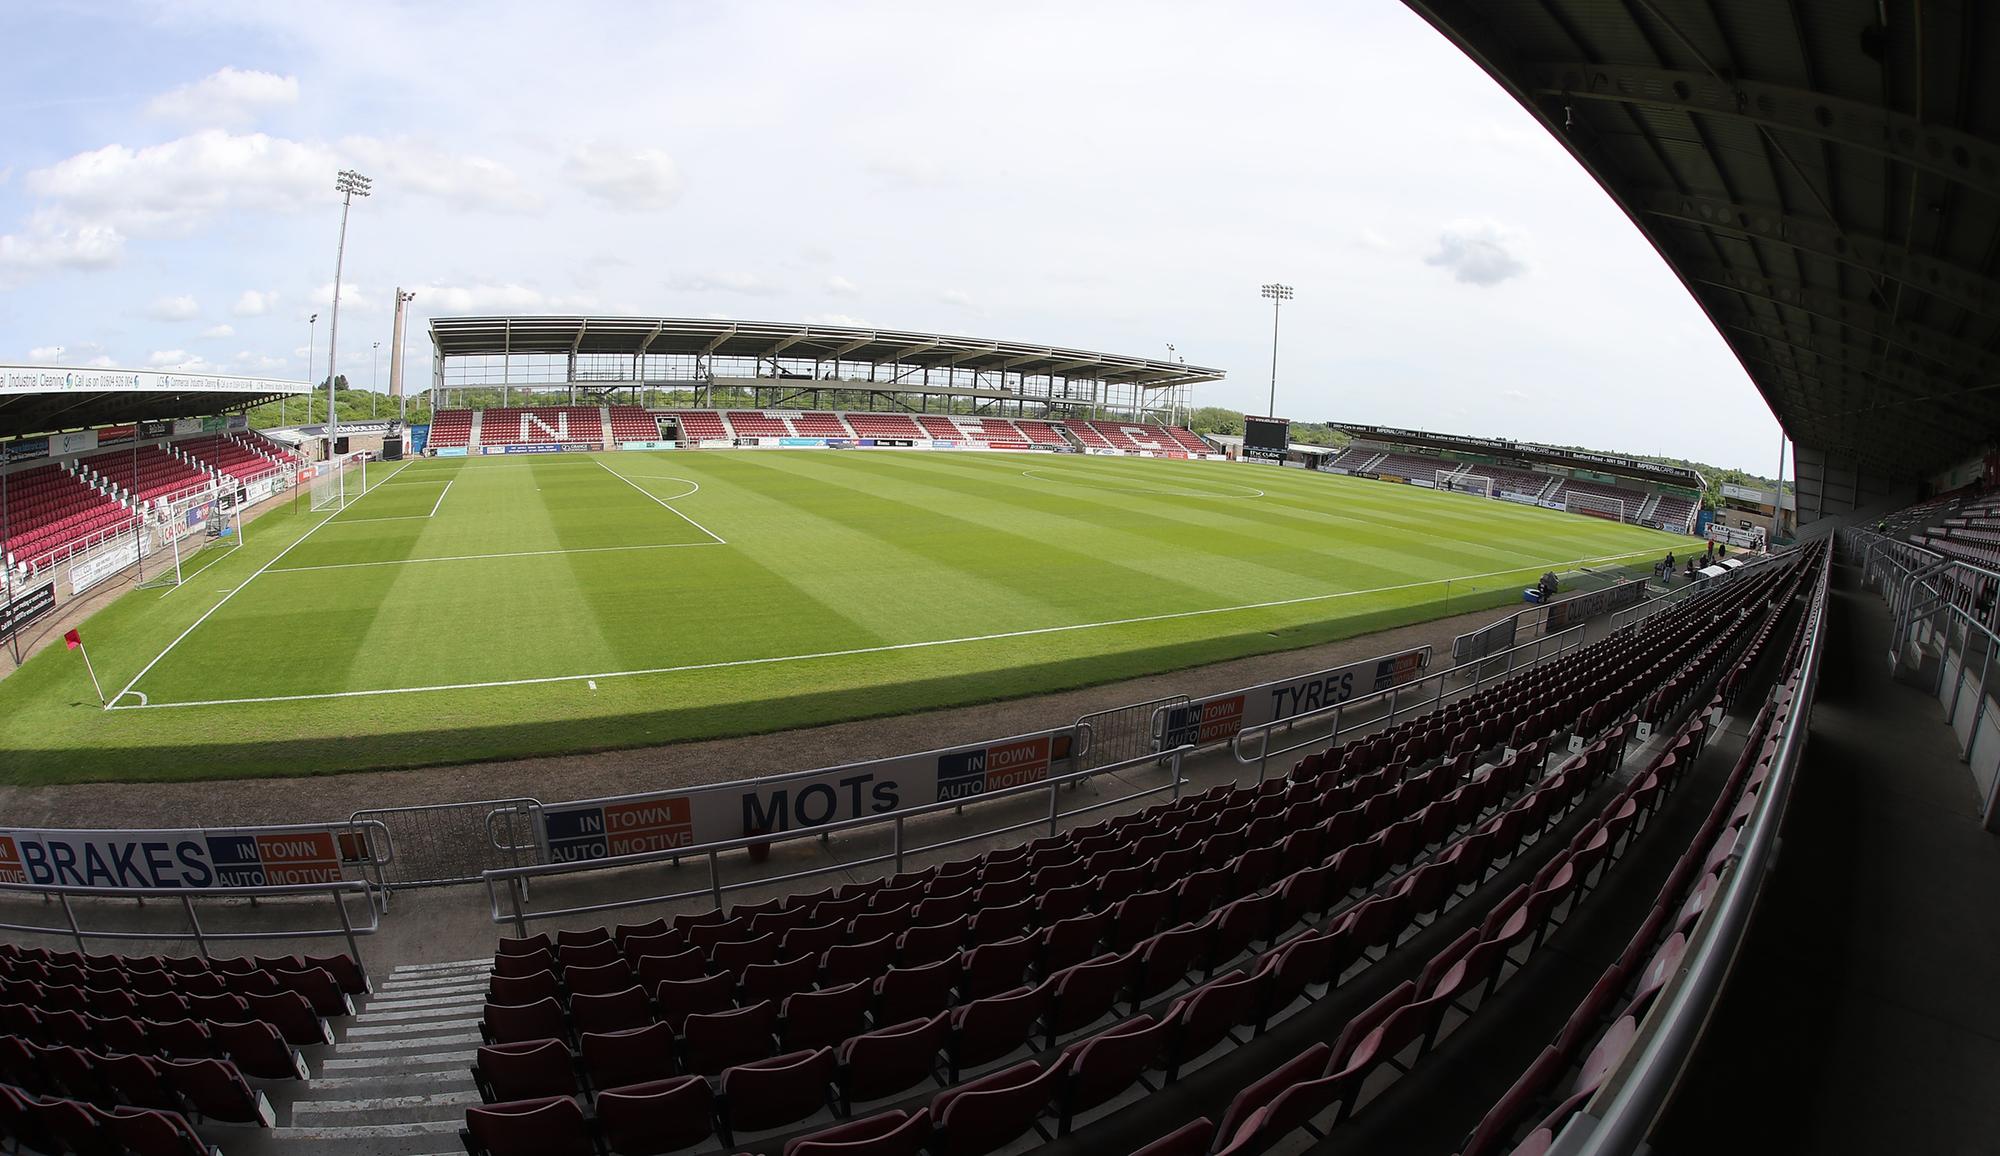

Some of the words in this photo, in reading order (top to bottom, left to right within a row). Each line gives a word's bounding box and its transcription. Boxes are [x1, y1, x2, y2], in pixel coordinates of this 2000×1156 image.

[9, 373, 38, 387] Industrial
[41, 374, 64, 389] Cleaning
[75, 375, 84, 387] Call
[1272, 672, 1353, 720] TYRES
[1189, 709, 1200, 723] IN
[1204, 702, 1235, 719] TOWN
[1200, 720, 1241, 739] MOTIVE
[967, 755, 984, 771] IN
[989, 746, 1036, 767] TOWN
[938, 780, 983, 800] AUTO
[988, 766, 1046, 790] MOTIVE
[742, 773, 899, 837] MOTs
[579, 815, 601, 833] IN
[607, 806, 672, 829] TOWN
[236, 843, 257, 860] IN
[260, 840, 318, 859] TOWN
[551, 842, 606, 863] AUTO
[613, 831, 692, 856] MOTIVE
[20, 840, 213, 888] BRAKES
[218, 871, 265, 887] AUTO
[270, 867, 342, 886] MOTIVE
